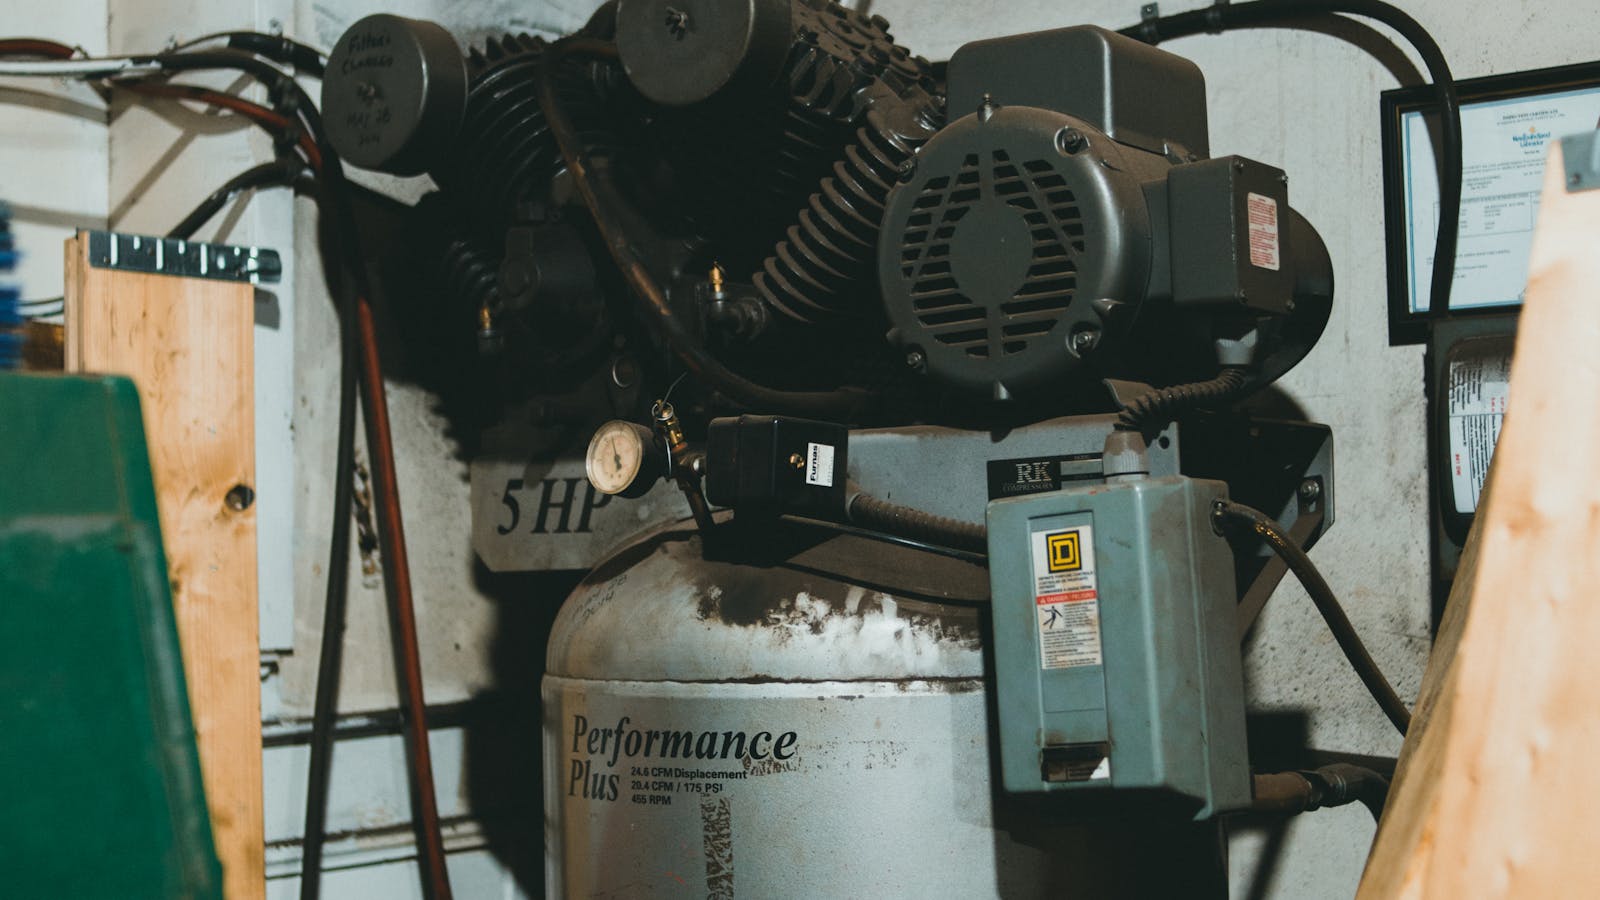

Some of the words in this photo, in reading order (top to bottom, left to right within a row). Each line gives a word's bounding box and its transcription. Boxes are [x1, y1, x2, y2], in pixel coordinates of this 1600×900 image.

[810, 446, 818, 482] Furnas
[1015, 461, 1052, 483] RK
[497, 478, 520, 535] 5
[531, 477, 613, 534] HP
[571, 714, 798, 767] Performance
[568, 759, 620, 802] Plus
[631, 766, 650, 777] 24.6
[651, 767, 673, 778] CFM
[674, 768, 748, 780] Displacement
[631, 780, 650, 791] 20.4
[651, 781, 673, 792] CFM
[684, 782, 702, 793] 175
[704, 783, 723, 794] PSI
[631, 794, 647, 804] 455
[649, 794, 672, 805] RPM
